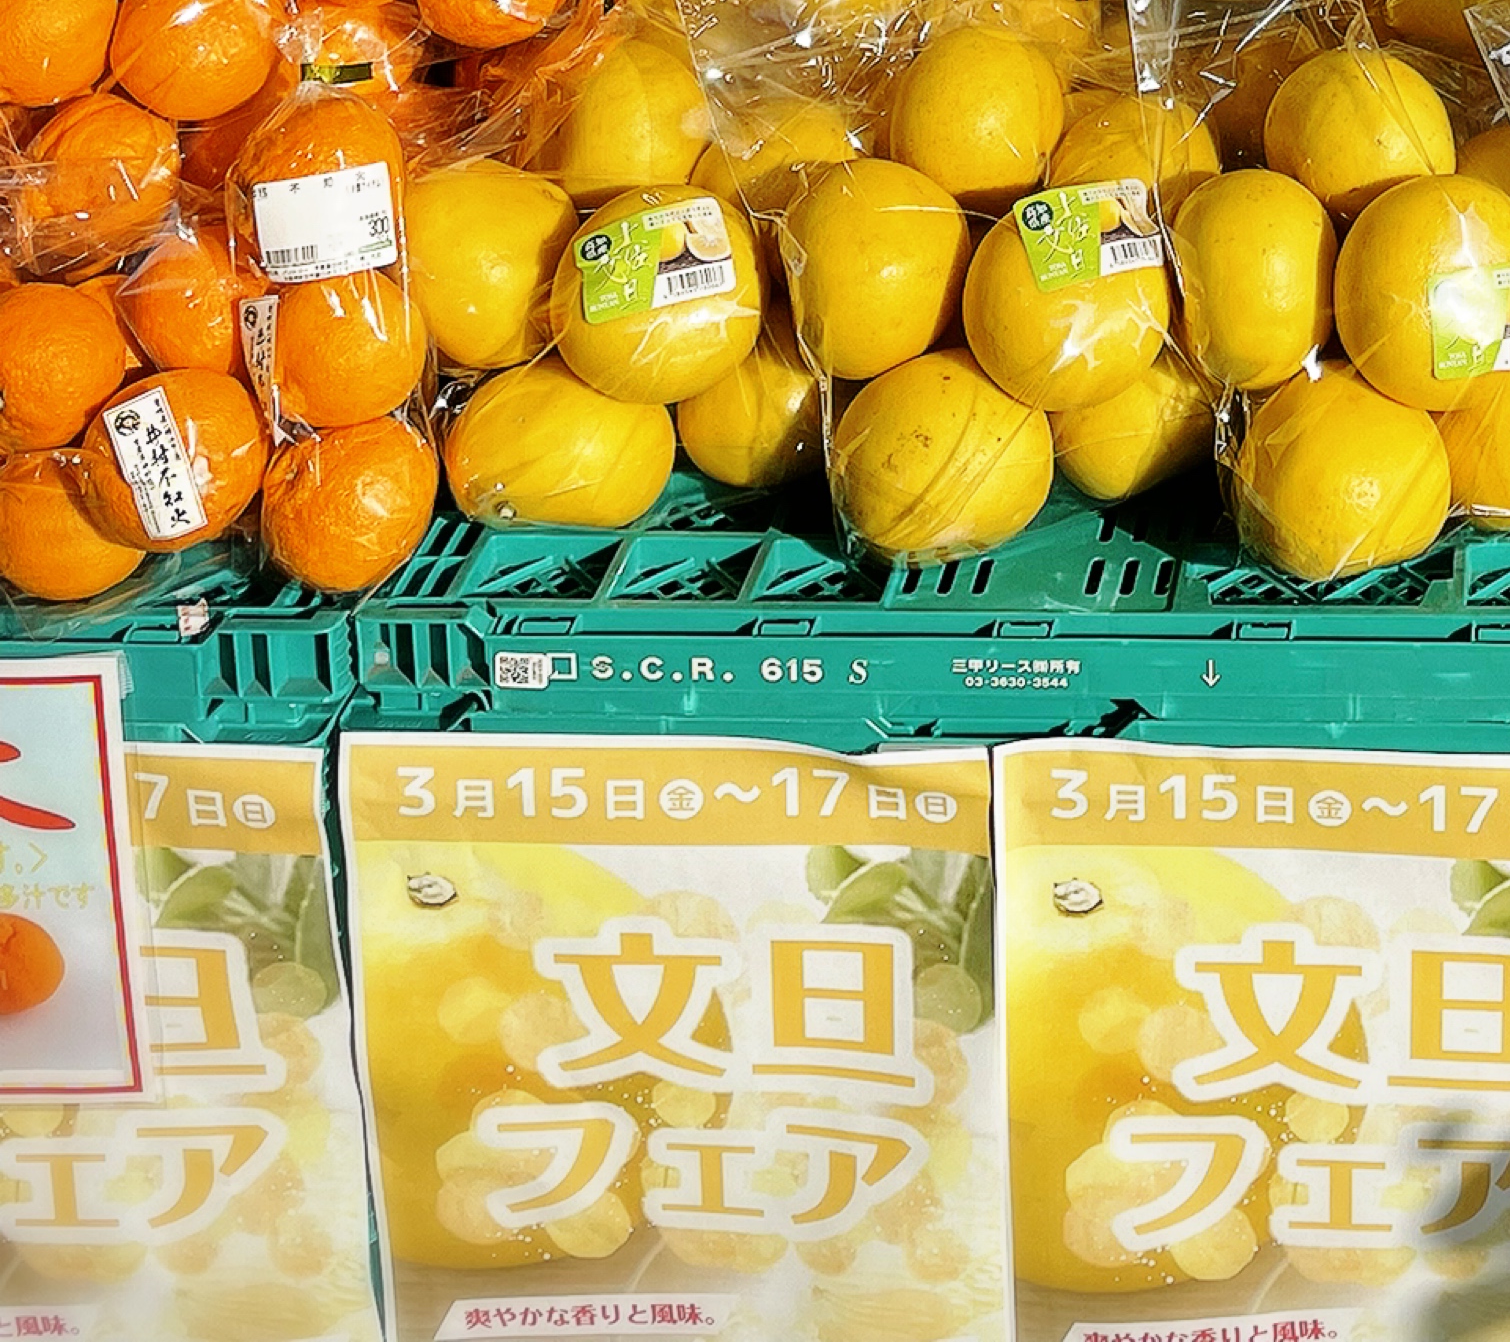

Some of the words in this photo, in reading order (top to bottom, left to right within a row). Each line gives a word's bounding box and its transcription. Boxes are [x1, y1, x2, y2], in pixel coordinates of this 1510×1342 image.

[591, 656, 735, 683] S.C.R.
[760, 659, 823, 683] 615
[847, 659, 869, 685] S
[554, 932, 916, 1088] 文旦
[498, 1118, 912, 1226] フェア
[464, 1303, 715, 1330] 爽やかな香りと風味。
